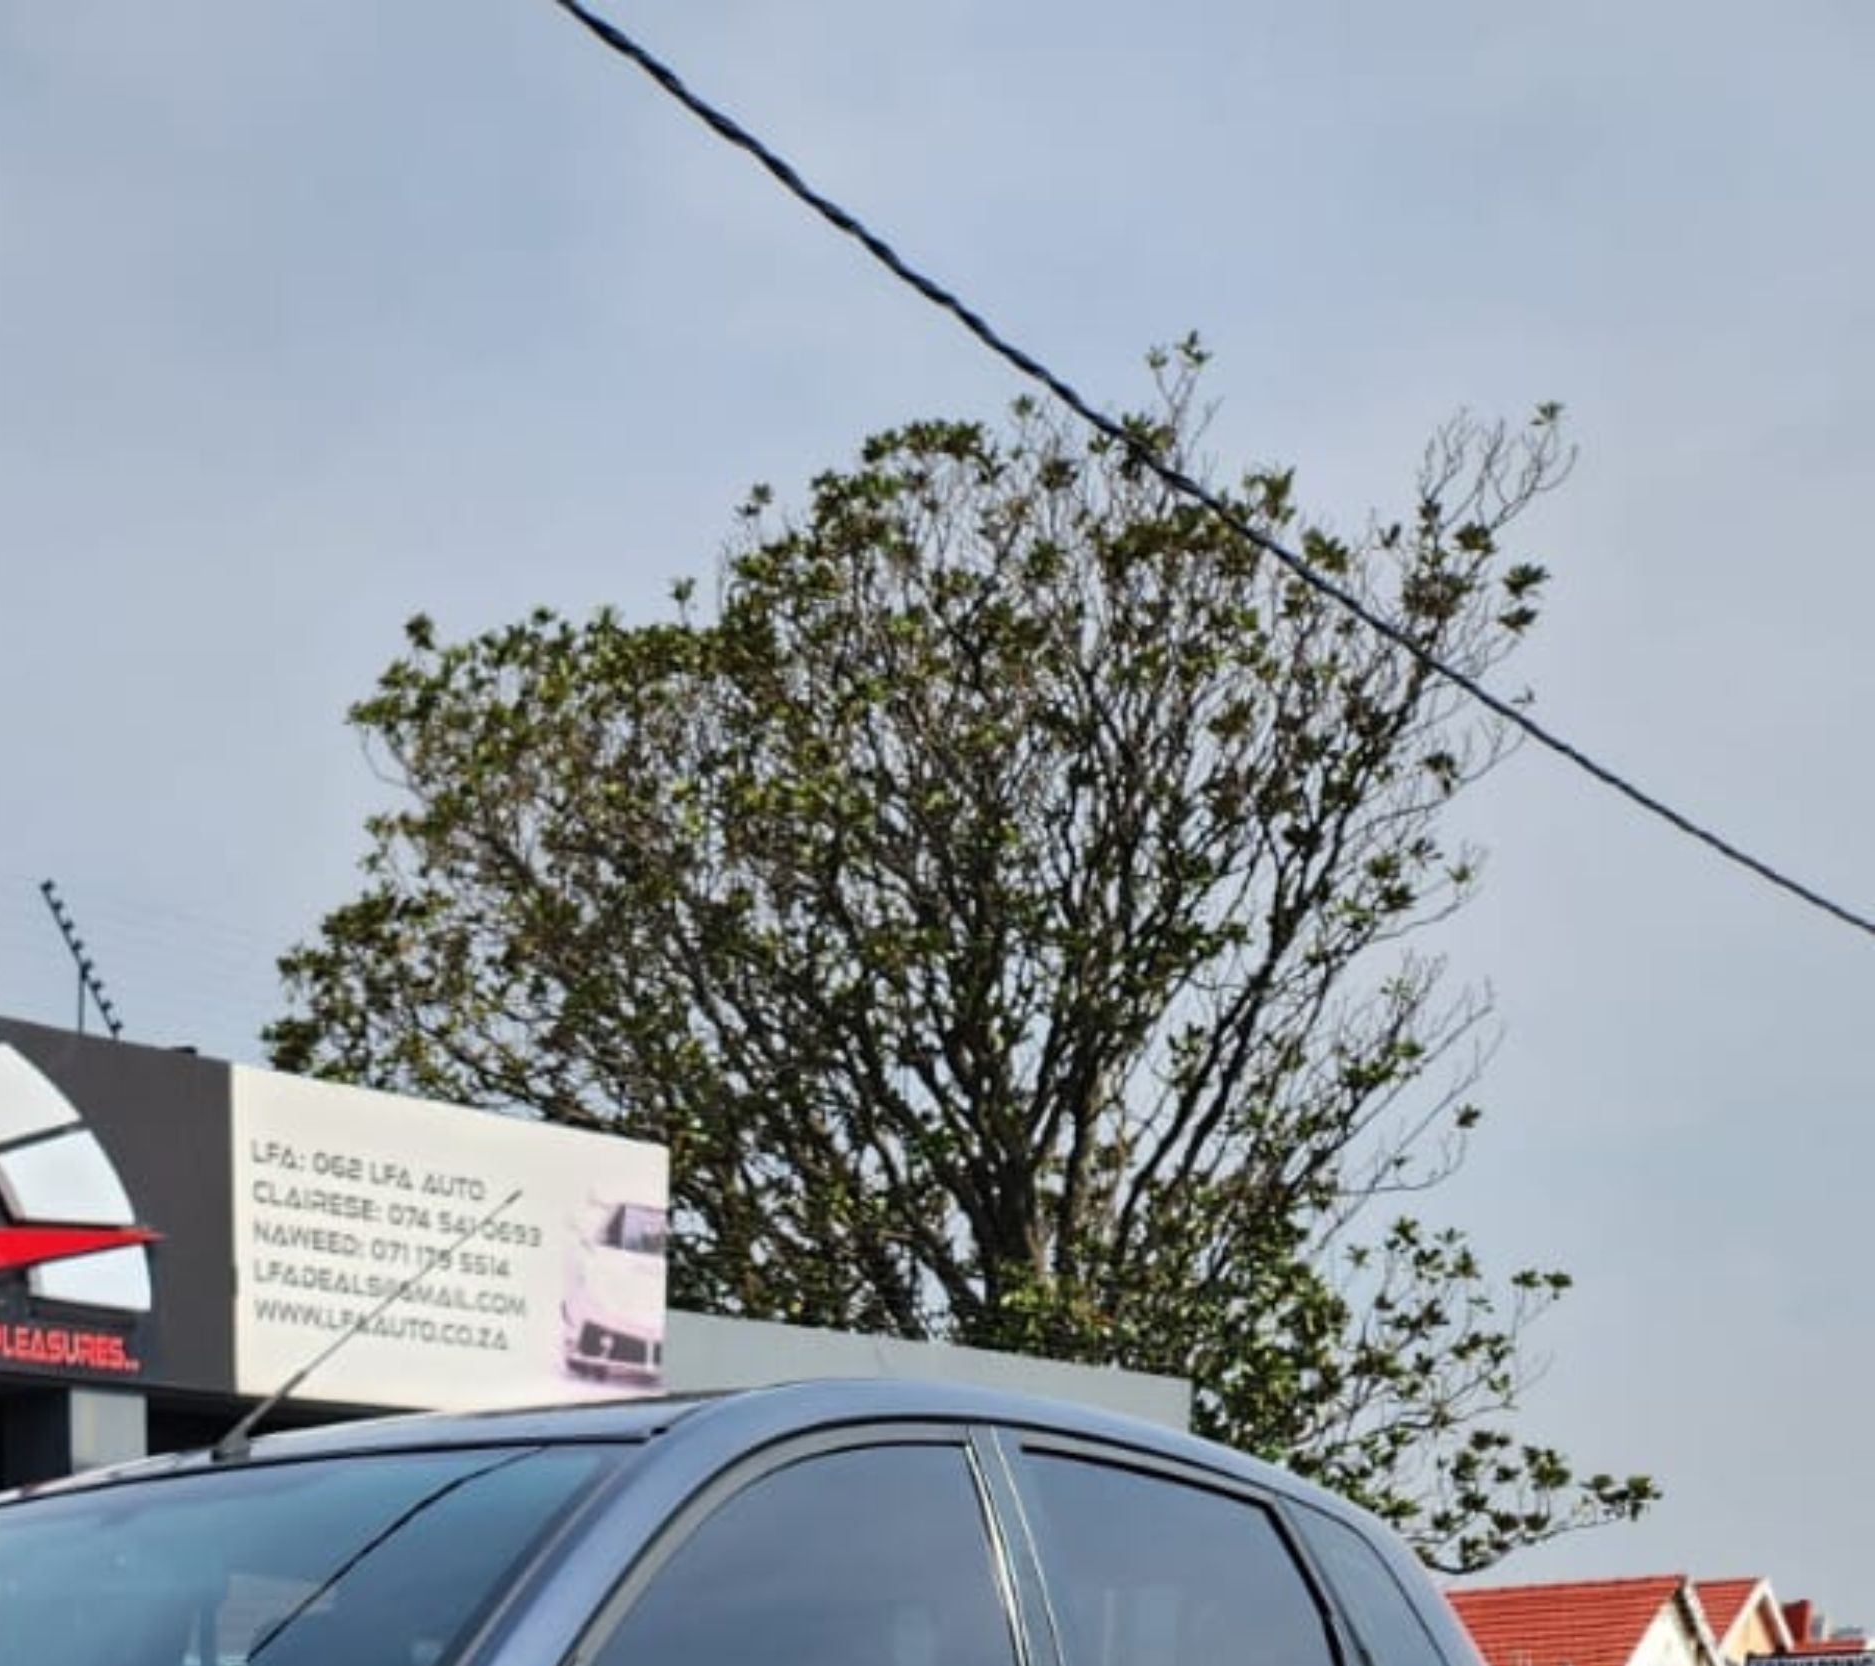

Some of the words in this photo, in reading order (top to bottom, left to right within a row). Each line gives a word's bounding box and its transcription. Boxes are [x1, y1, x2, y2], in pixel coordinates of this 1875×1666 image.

[251, 1137, 307, 1171] LFA:
[368, 1161, 415, 1192] LFA
[421, 1171, 487, 1203] AUTO
[387, 1201, 432, 1232] 074
[252, 1220, 366, 1260] NAWEED:
